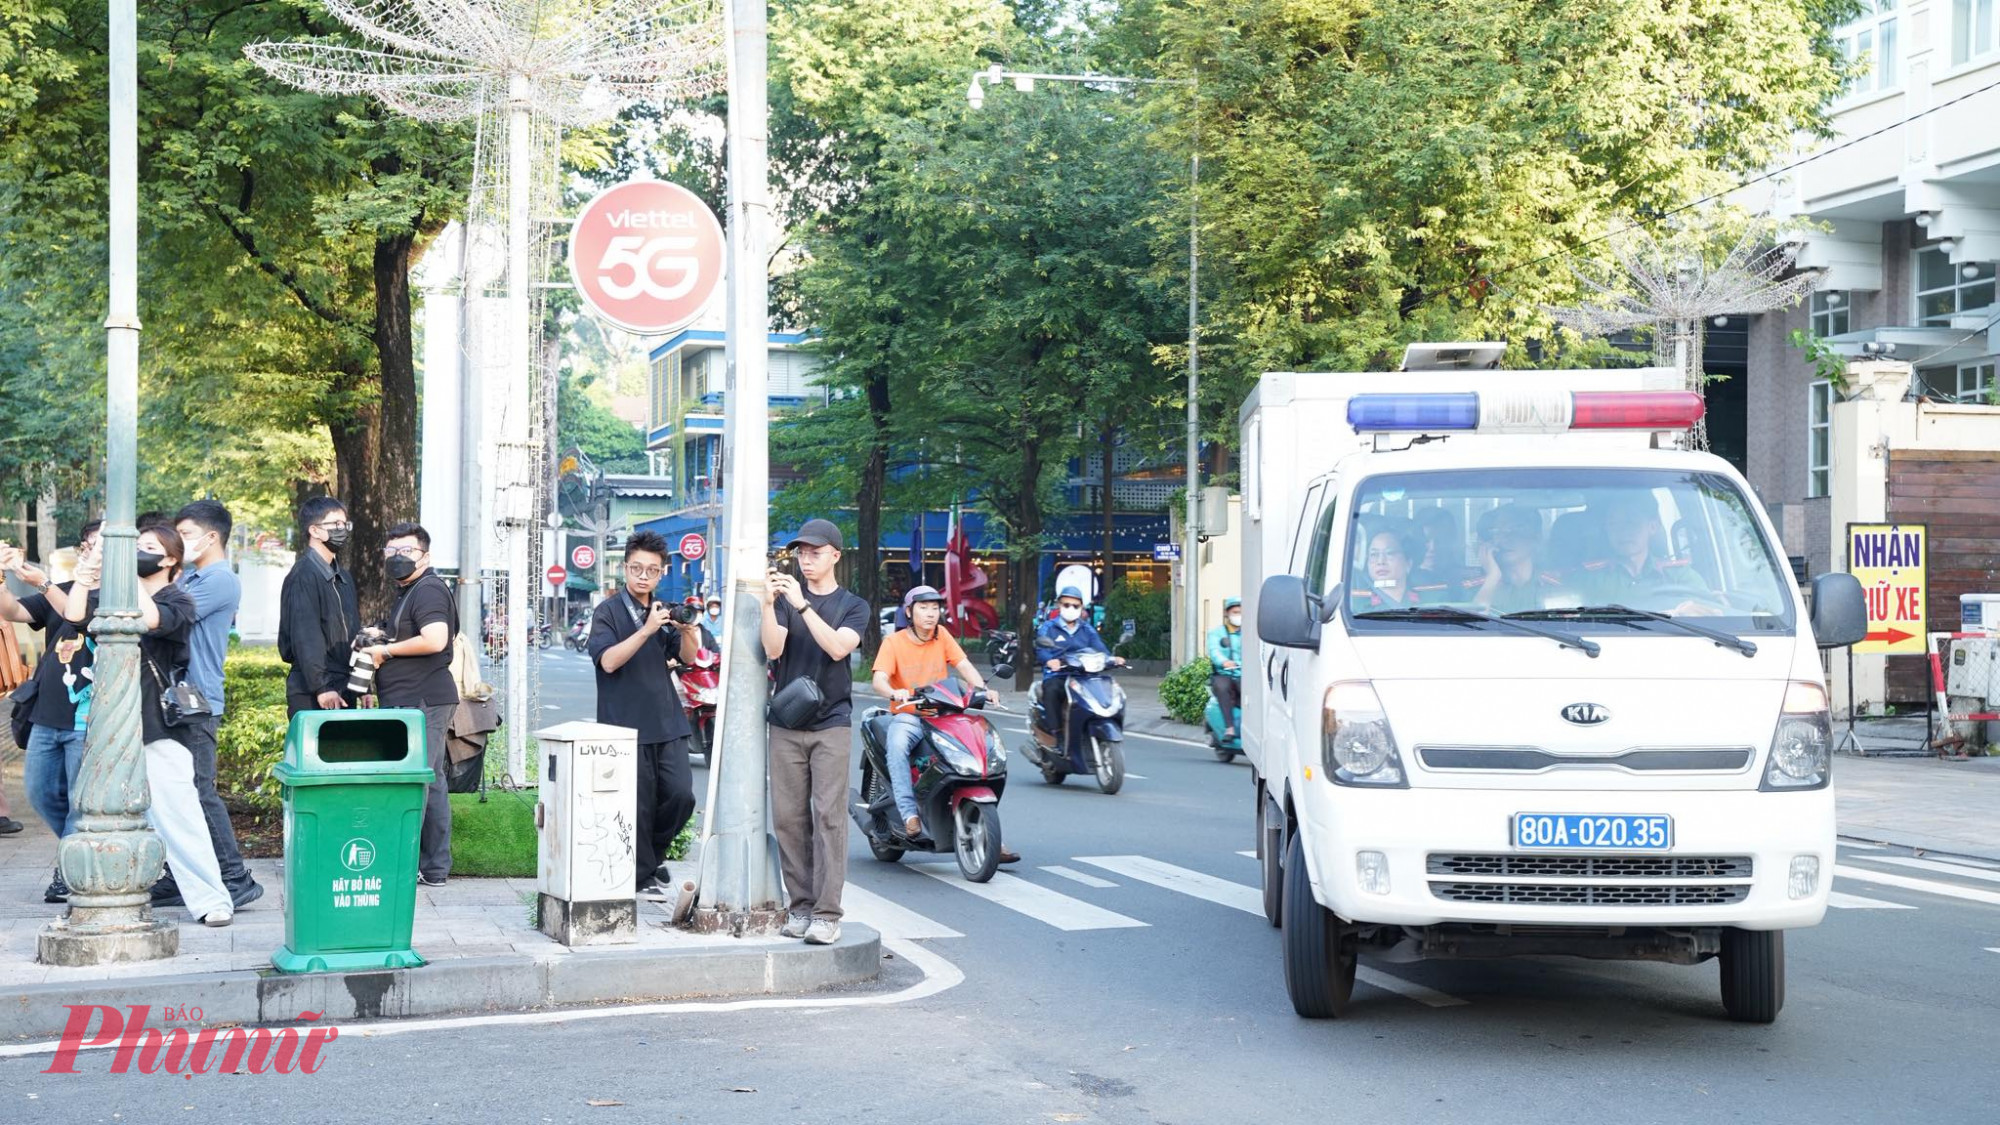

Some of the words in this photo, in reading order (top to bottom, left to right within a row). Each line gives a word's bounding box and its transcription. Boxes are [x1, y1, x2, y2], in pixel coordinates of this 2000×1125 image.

[605, 209, 698, 229] viettel
[597, 236, 699, 301] 5G
[684, 543, 702, 555] 5G
[1854, 526, 1921, 576] NHẬN
[1862, 580, 1890, 621] IỮ
[1895, 586, 1920, 621] XE
[1567, 705, 1608, 721] KIA
[1521, 817, 1665, 846] 80A-020.35
[332, 877, 350, 892] HÃY
[351, 875, 363, 892] BỎ
[364, 876, 382, 891] RÁC
[333, 893, 351, 908] VÀO
[352, 892, 380, 907] THÙNG
